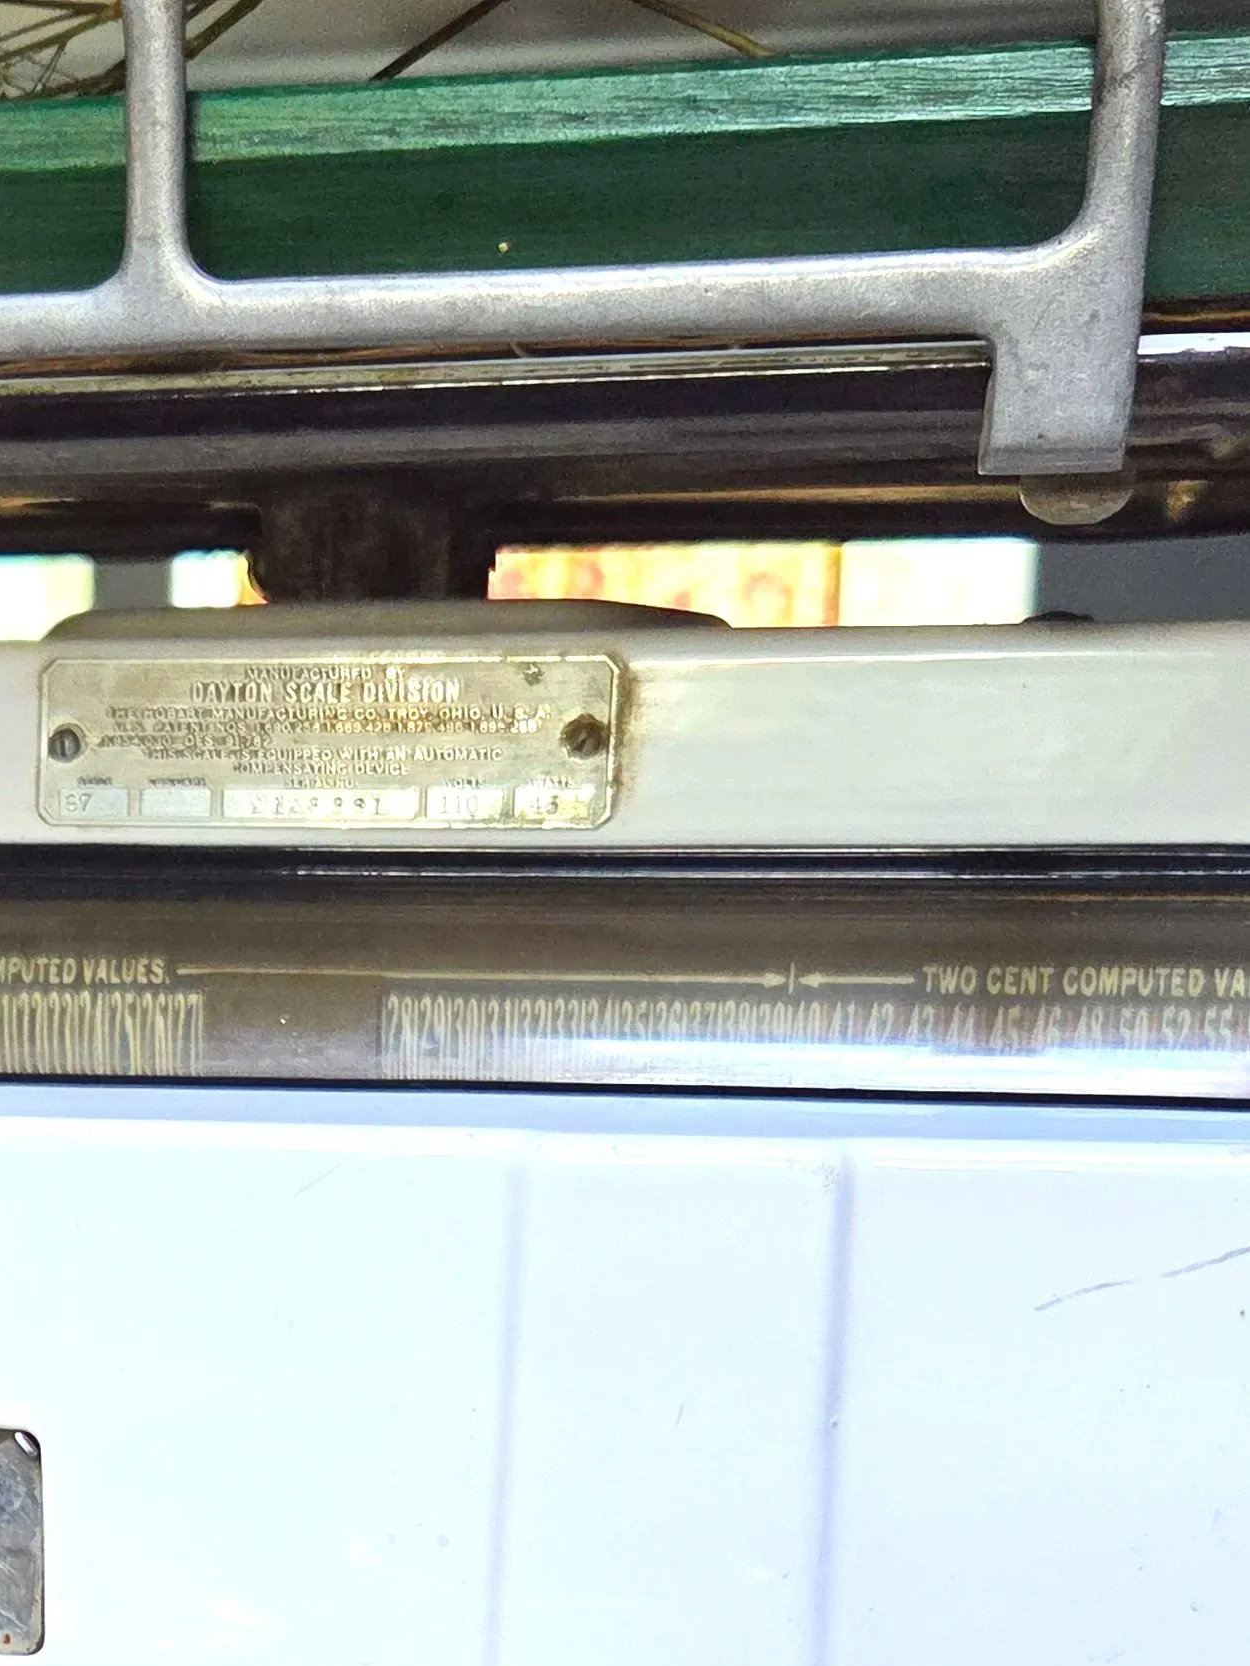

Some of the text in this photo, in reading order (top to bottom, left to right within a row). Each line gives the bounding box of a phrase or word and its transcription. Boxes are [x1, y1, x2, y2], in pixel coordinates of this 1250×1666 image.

[246, 665, 405, 681] MANUFACTURED BY
[191, 676, 461, 704] DAYTON SCALE DIVISION
[211, 706, 348, 721] MANUFACTURING
[183, 749, 228, 761] SCALE
[257, 747, 333, 761] EQUIPPED
[338, 746, 379, 761] WITH
[385, 746, 407, 761] AN
[413, 746, 503, 761] AUTOMATIC
[354, 761, 409, 775] DEVICE
[921, 964, 978, 996] TWO
[986, 964, 1055, 996] CENT
[1062, 965, 1207, 998] COMPUTED
